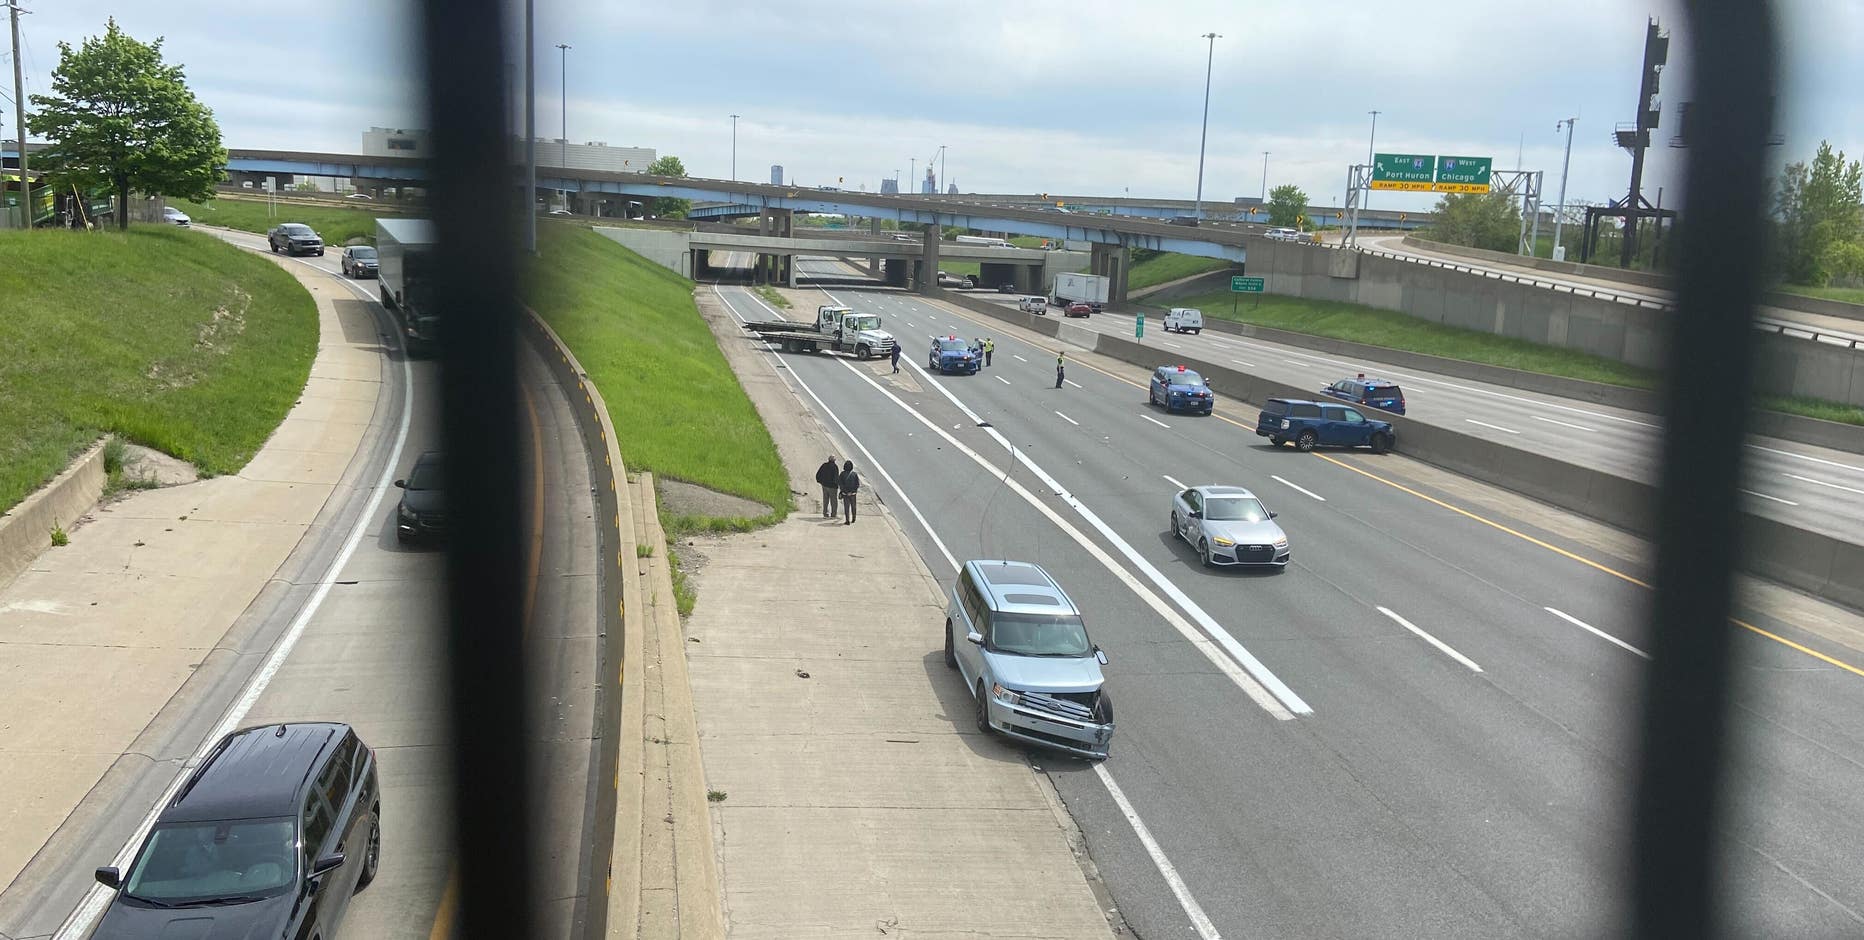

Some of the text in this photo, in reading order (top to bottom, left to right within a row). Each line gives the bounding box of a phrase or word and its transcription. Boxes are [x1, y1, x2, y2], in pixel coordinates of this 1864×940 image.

[1385, 171, 1430, 180] Port Huron
[1441, 173, 1475, 182] Chicago
